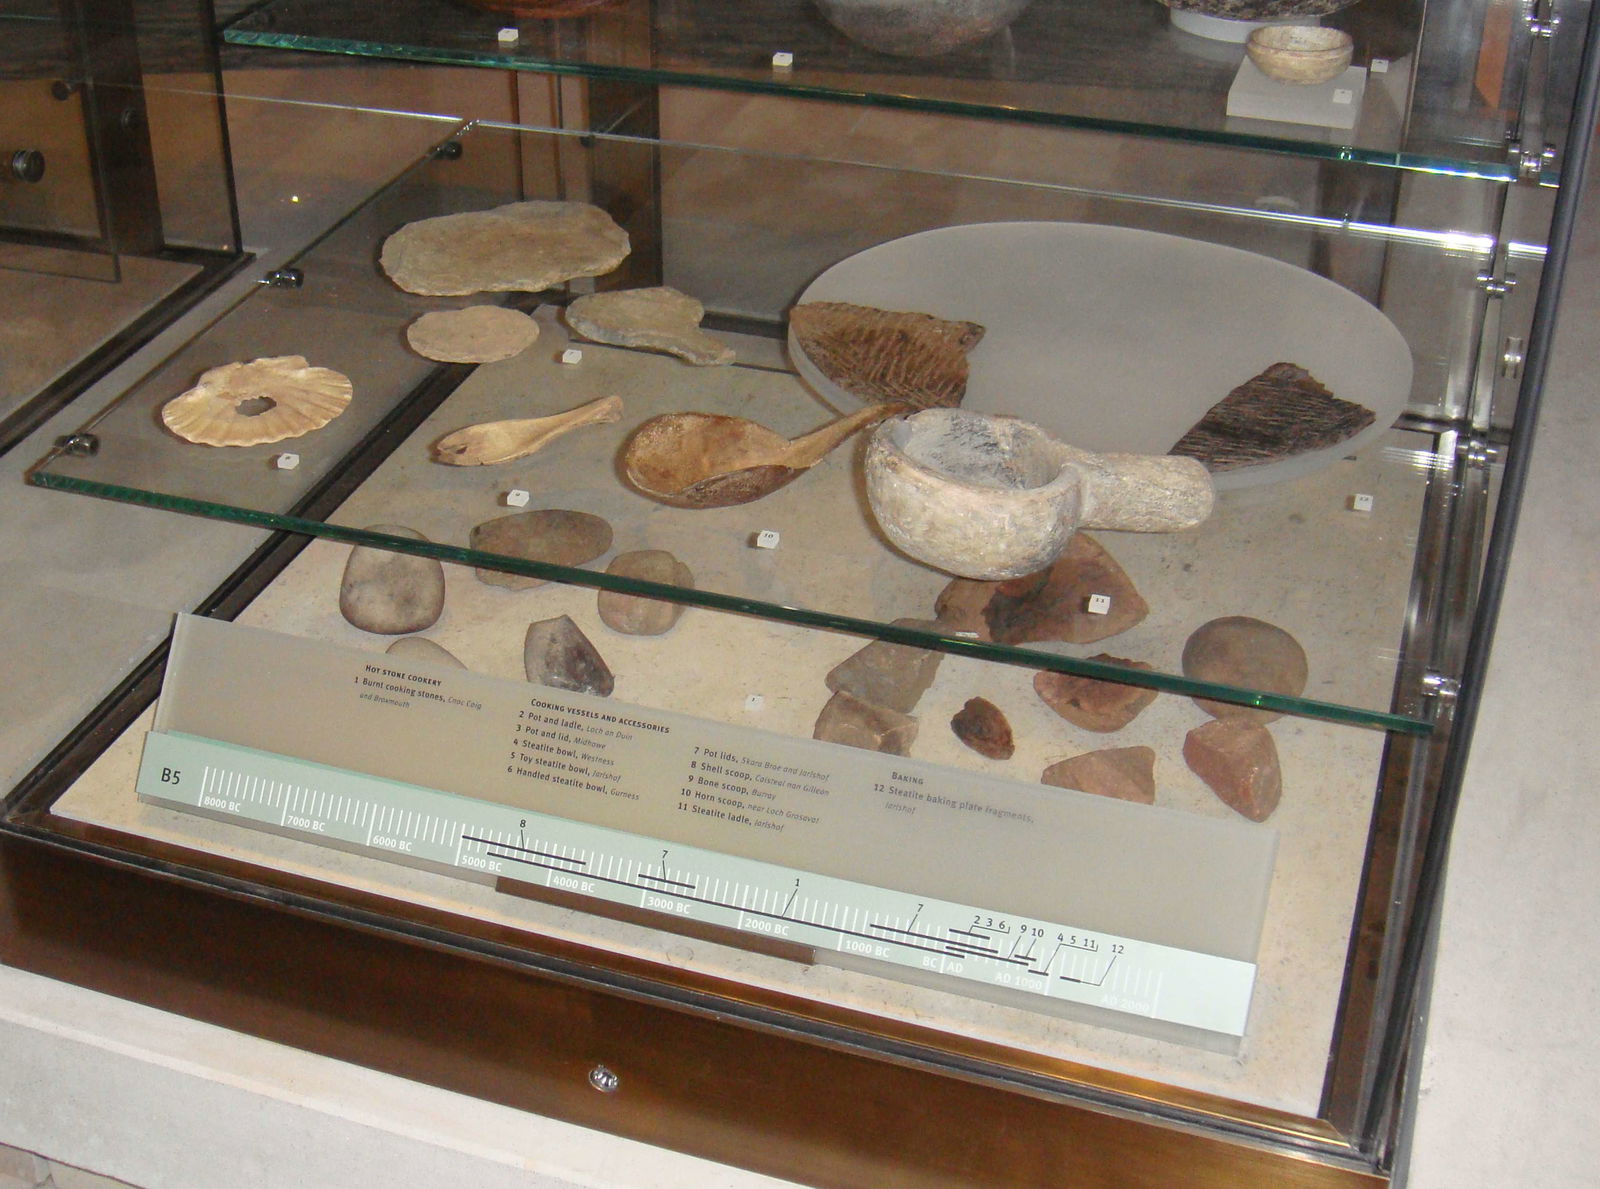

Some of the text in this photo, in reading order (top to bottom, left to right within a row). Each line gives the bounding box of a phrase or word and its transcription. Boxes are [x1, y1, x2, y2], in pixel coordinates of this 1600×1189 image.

[365, 665, 442, 686] HOT STONE COOKERY
[362, 678, 383, 688] Burnt
[386, 682, 416, 696] cooking
[418, 690, 446, 702] stones,
[528, 713, 541, 722] Pot
[544, 716, 559, 725] and
[561, 719, 583, 731] ladle,
[531, 698, 670, 734] COOKING VESSELS AND ACCESSORIES
[526, 726, 538, 735] Pot
[541, 730, 556, 739] and
[558, 733, 572, 743] lid,
[522, 740, 553, 752] Steatite
[557, 747, 578, 759] bowl,
[520, 753, 532, 764] Toy
[535, 757, 566, 770] steatite
[569, 764, 590, 776] bowl,
[704, 749, 717, 758] Pot
[720, 751, 738, 763] lids,
[783, 766, 798, 775] and
[160, 768, 181, 785] B5
[701, 762, 723, 774] Shell
[725, 769, 752, 781] scoop,
[517, 767, 550, 781] Handled
[552, 775, 583, 788] steatite
[586, 783, 608, 794] bowl,
[698, 777, 719, 788] Bone
[722, 783, 748, 795] scoop,
[204, 796, 240, 812] 8000 BC
[681, 788, 691, 796] 10
[695, 791, 715, 801] Horn
[718, 796, 744, 809] scoop,
[748, 804, 764, 812] near
[874, 784, 884, 792] 12
[888, 786, 924, 800] Steatite
[927, 794, 956, 809] baking
[959, 802, 982, 812] plate
[678, 802, 687, 811] 11
[692, 805, 725, 819] Steatite
[728, 813, 752, 825] ladle,
[287, 815, 325, 832] 7000 BC
[520, 819, 526, 828] 8
[373, 835, 412, 852] 6000 BC
[662, 850, 668, 859] 7
[461, 855, 502, 872] 5000 BC
[553, 876, 595, 893] 4000 BC
[796, 878, 800, 887] 1
[647, 897, 690, 914] 3000 BC
[918, 904, 924, 912] 7
[744, 918, 789, 936] 2000 BC
[974, 915, 1005, 930] 2 3 6
[1020, 925, 1027, 934] 9
[1031, 928, 1044, 938] 10
[1057, 933, 1095, 948] 4 5 11
[846, 940, 890, 958] 1000 BC
[1112, 944, 1124, 954] 12
[922, 957, 937, 969] BC
[947, 962, 963, 974] AD
[995, 973, 1043, 990] AD 1000
